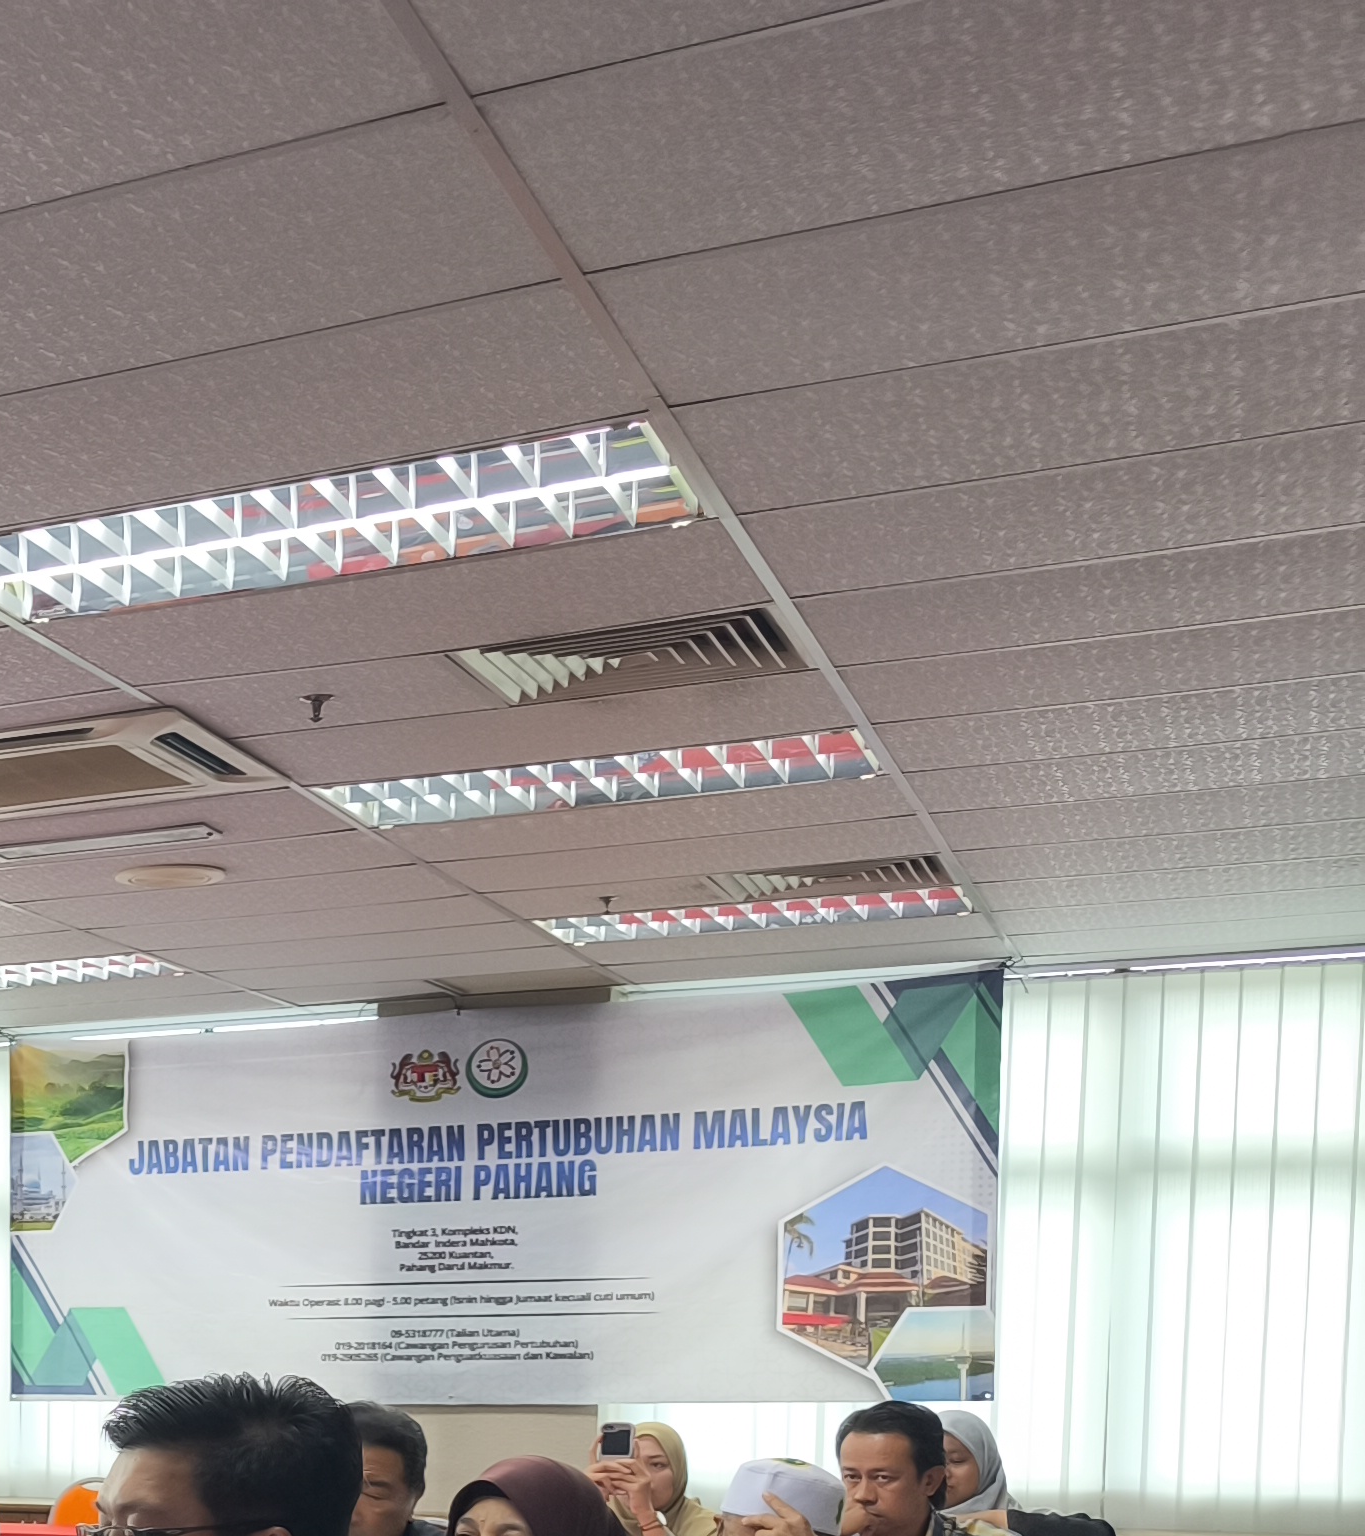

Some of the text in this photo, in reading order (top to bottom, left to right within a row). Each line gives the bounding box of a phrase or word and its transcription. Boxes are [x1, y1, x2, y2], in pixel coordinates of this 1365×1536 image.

[129, 1100, 868, 1176] JABATAN PENDAFTARAN PERTUBUHAN MALAYSIA
[359, 1159, 598, 1206] NEGERI PAHANG
[391, 1228, 429, 1240] Tingkat
[441, 1226, 490, 1238] Kompleks
[493, 1225, 519, 1236] KDN,
[395, 1237, 518, 1249] Bandar Indera Mahkota,
[448, 1250, 494, 1260] Kuantan,
[399, 1261, 515, 1274] Pahang Darul Makmur.
[392, 1296, 412, 1305] 5.00
[414, 1296, 449, 1307] petang
[480, 1295, 513, 1306] hingga
[482, 1328, 520, 1338] Utama)
[514, 1339, 579, 1349] Pertubuhan)
[523, 1351, 543, 1360] dan
